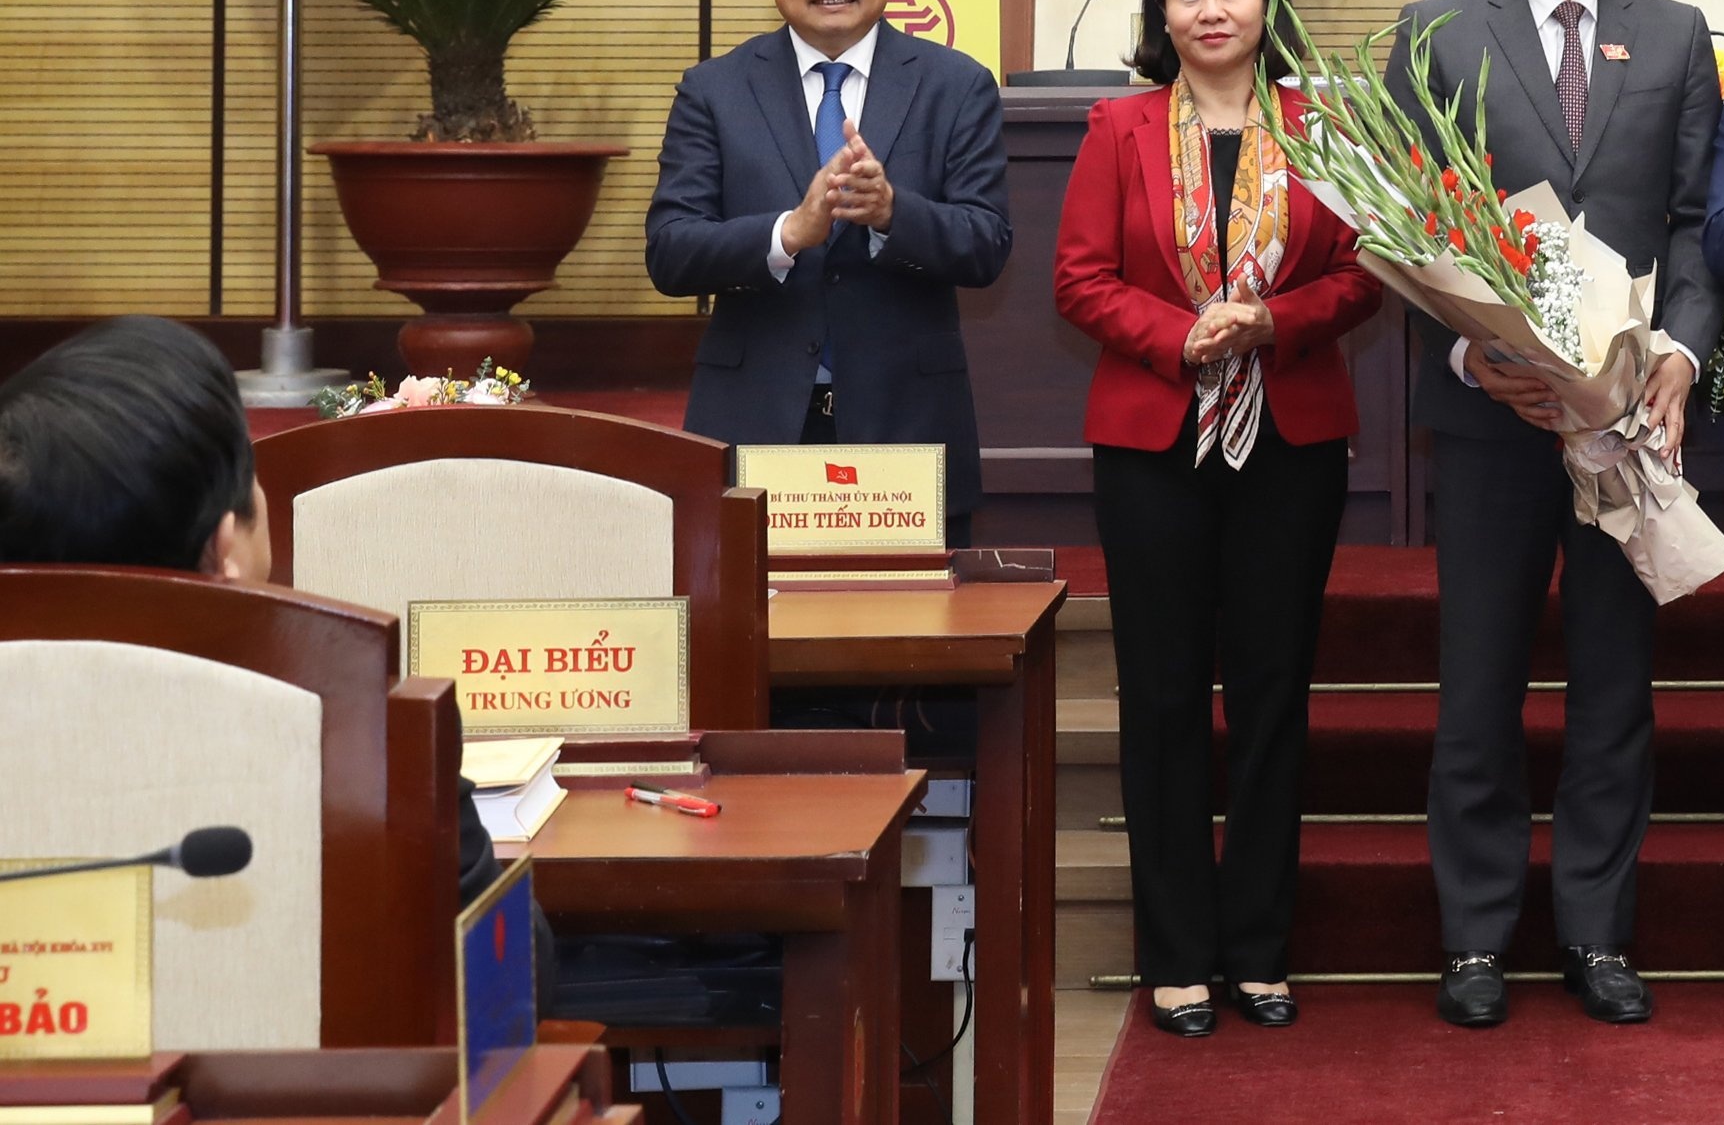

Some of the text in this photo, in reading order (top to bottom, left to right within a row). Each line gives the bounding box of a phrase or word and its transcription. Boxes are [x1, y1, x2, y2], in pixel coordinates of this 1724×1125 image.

[770, 488, 913, 504] BÍ THƯ THÀNH ỦY HÀ NỘI
[813, 504, 861, 529] TIẾN
[867, 506, 927, 529] DŨNG
[461, 629, 636, 681] ĐẠI BIỂU
[465, 687, 633, 711] TRUNG ƯƠNG
[0, 986, 89, 1037] BẢO
